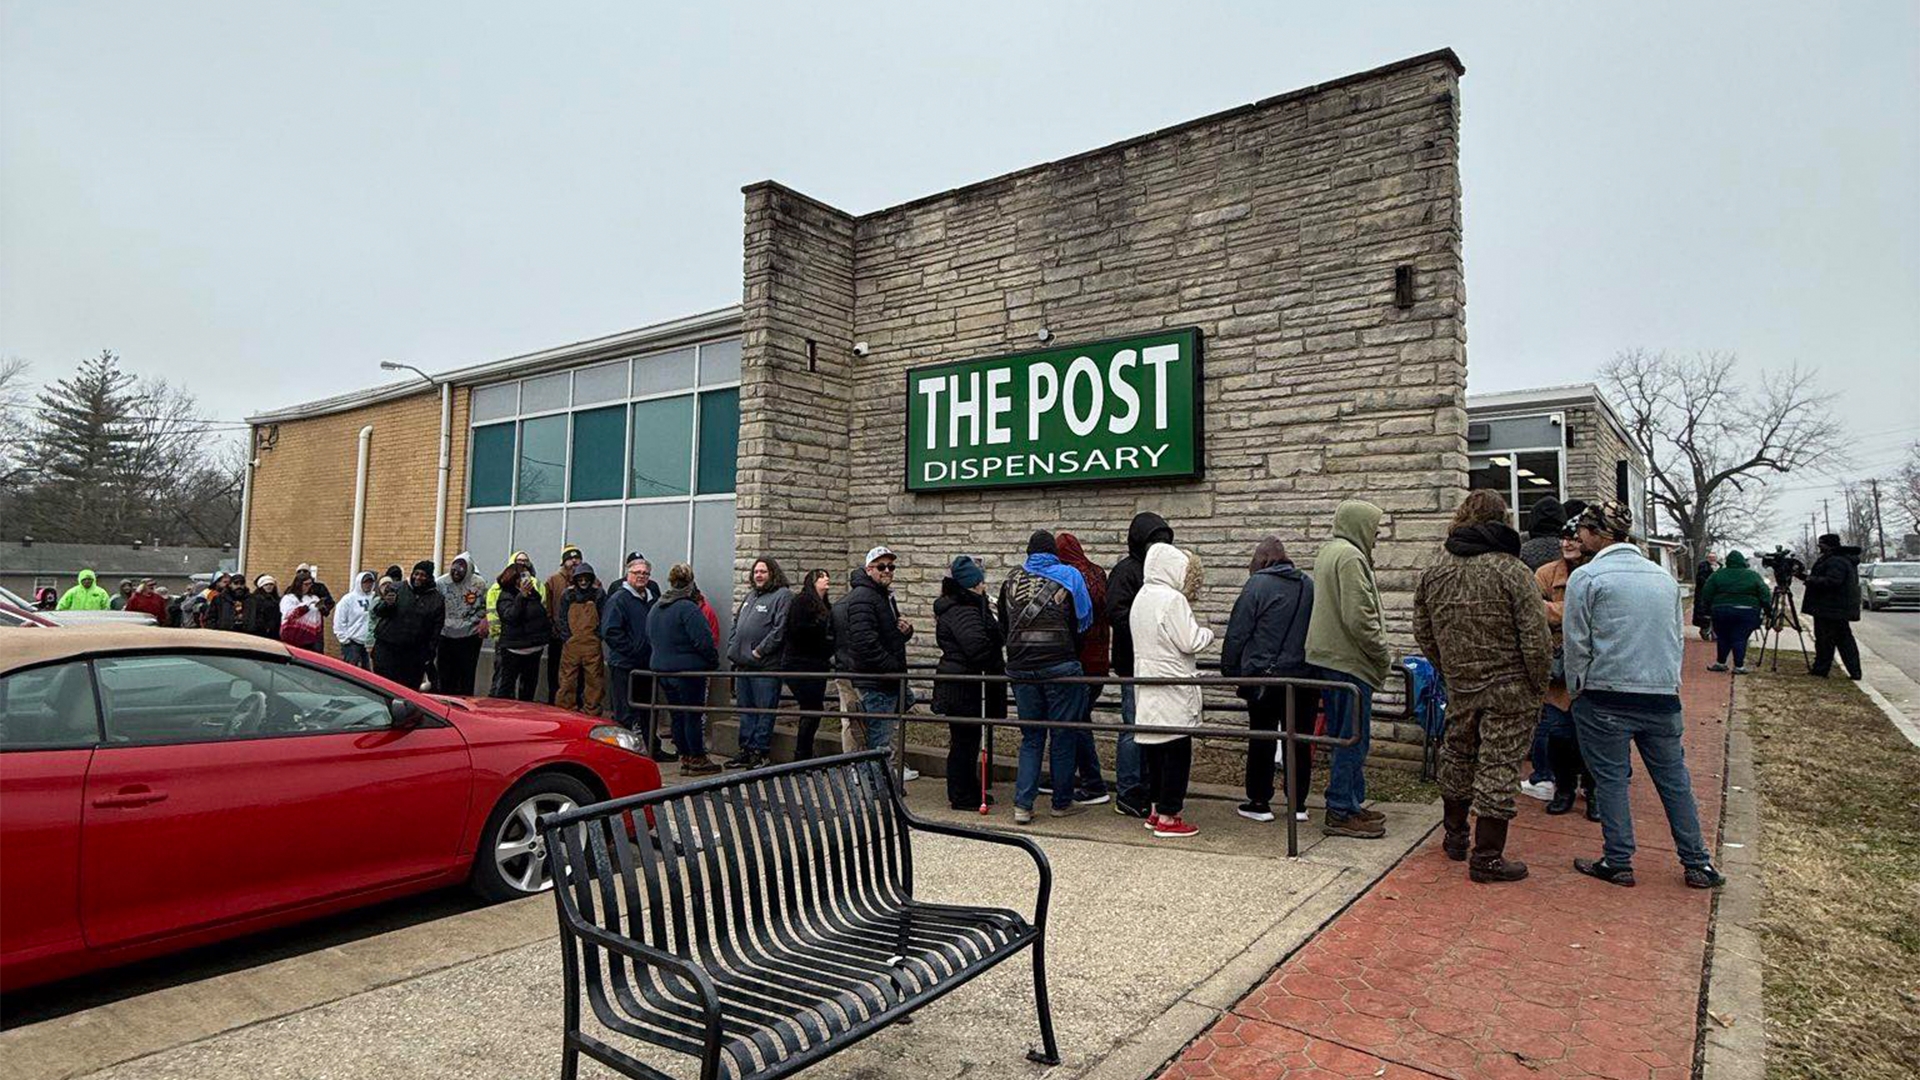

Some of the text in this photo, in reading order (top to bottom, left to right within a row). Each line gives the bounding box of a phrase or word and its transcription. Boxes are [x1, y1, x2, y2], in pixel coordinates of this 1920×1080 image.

[918, 343, 1180, 450] THE POST
[924, 443, 1169, 482] DISPENSARY
